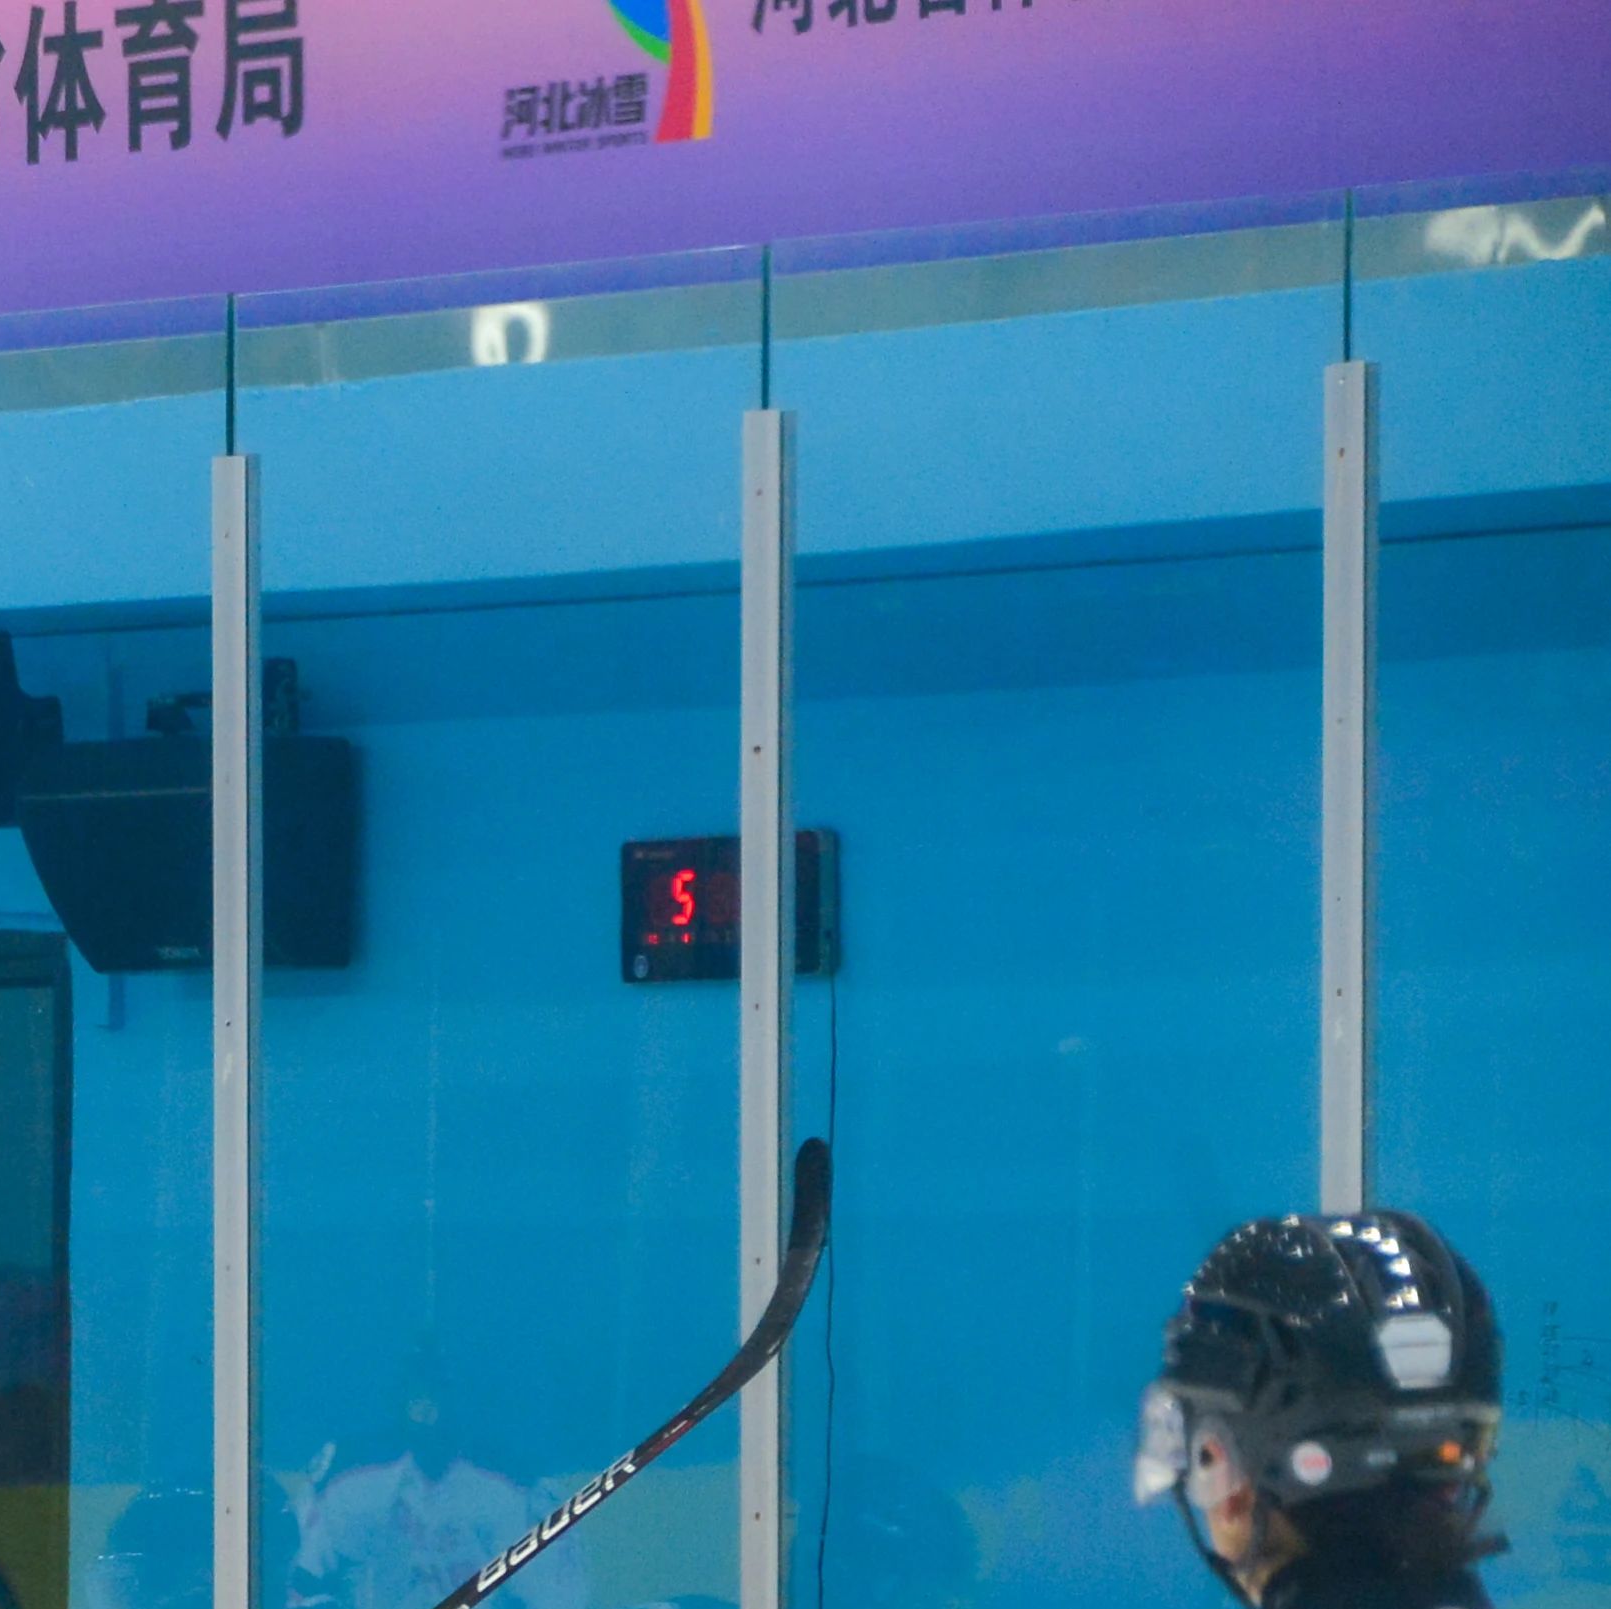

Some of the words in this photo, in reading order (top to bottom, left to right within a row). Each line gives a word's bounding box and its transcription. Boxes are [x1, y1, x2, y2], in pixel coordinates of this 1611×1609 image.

[500, 73, 648, 141] 河北冰雪
[476, 1449, 637, 1594] BAUER
